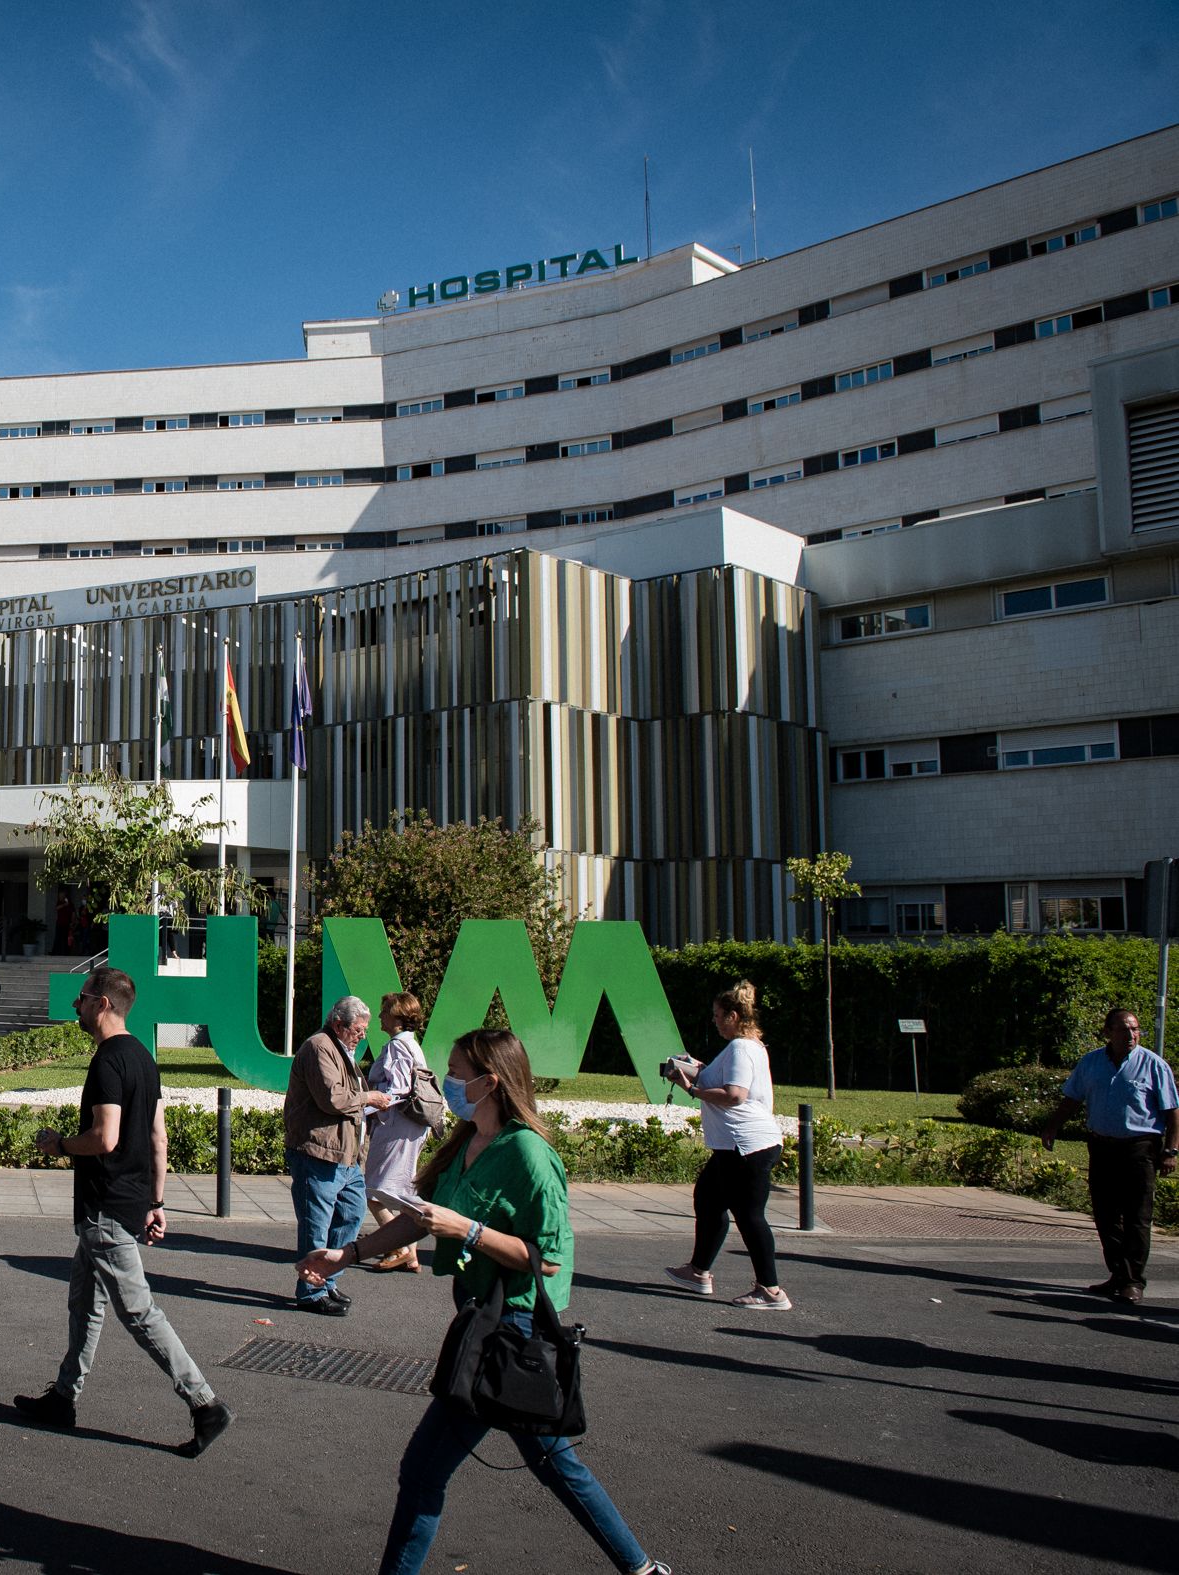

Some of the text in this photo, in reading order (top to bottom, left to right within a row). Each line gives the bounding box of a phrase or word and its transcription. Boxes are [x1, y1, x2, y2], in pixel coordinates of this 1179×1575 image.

[408, 243, 639, 307] HOSPITAL
[86, 569, 254, 605] UNIVERSITARIO
[111, 596, 207, 619] MACARENA
